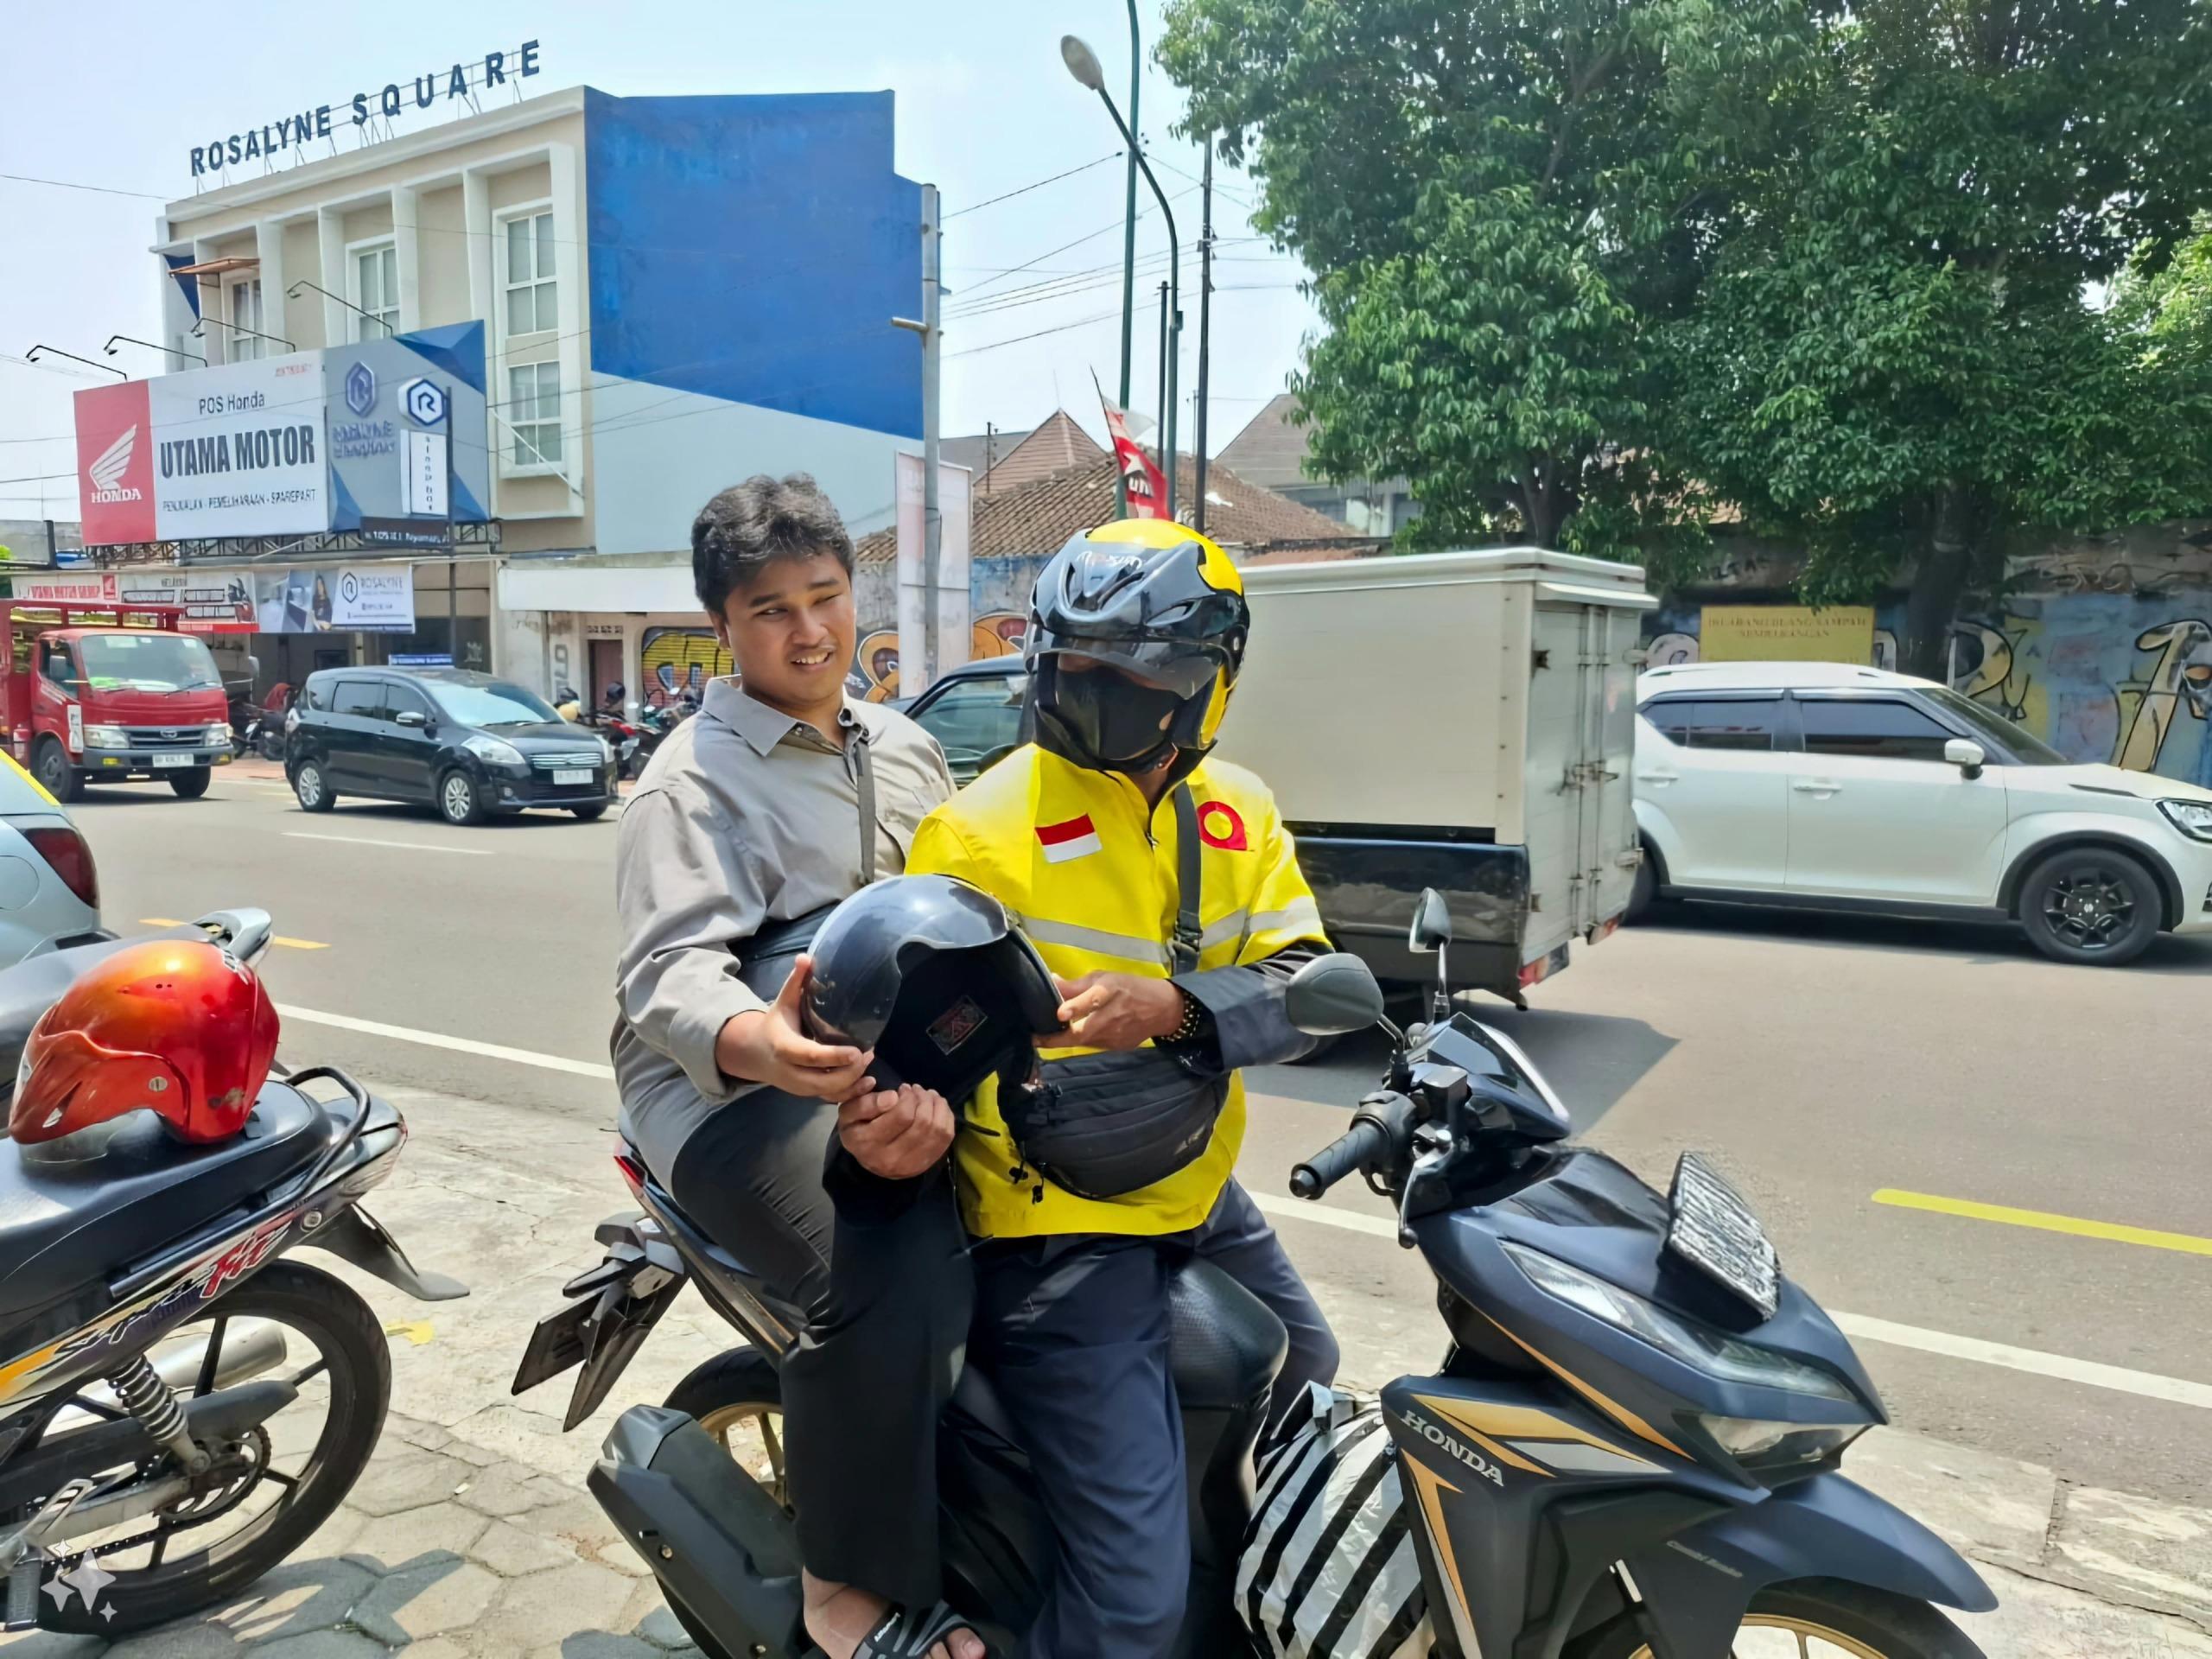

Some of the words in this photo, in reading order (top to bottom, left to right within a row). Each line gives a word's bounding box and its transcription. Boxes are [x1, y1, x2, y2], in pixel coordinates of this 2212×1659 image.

[190, 105, 331, 176] ROSALYNE
[352, 39, 540, 125] SQUARE
[200, 397, 224, 416] POS
[227, 391, 265, 410] Honda
[160, 435, 231, 479] UTAMA
[234, 425, 315, 471] MOTOR
[91, 487, 142, 503] HONDA
[1401, 1409, 1504, 1487] HONDA
